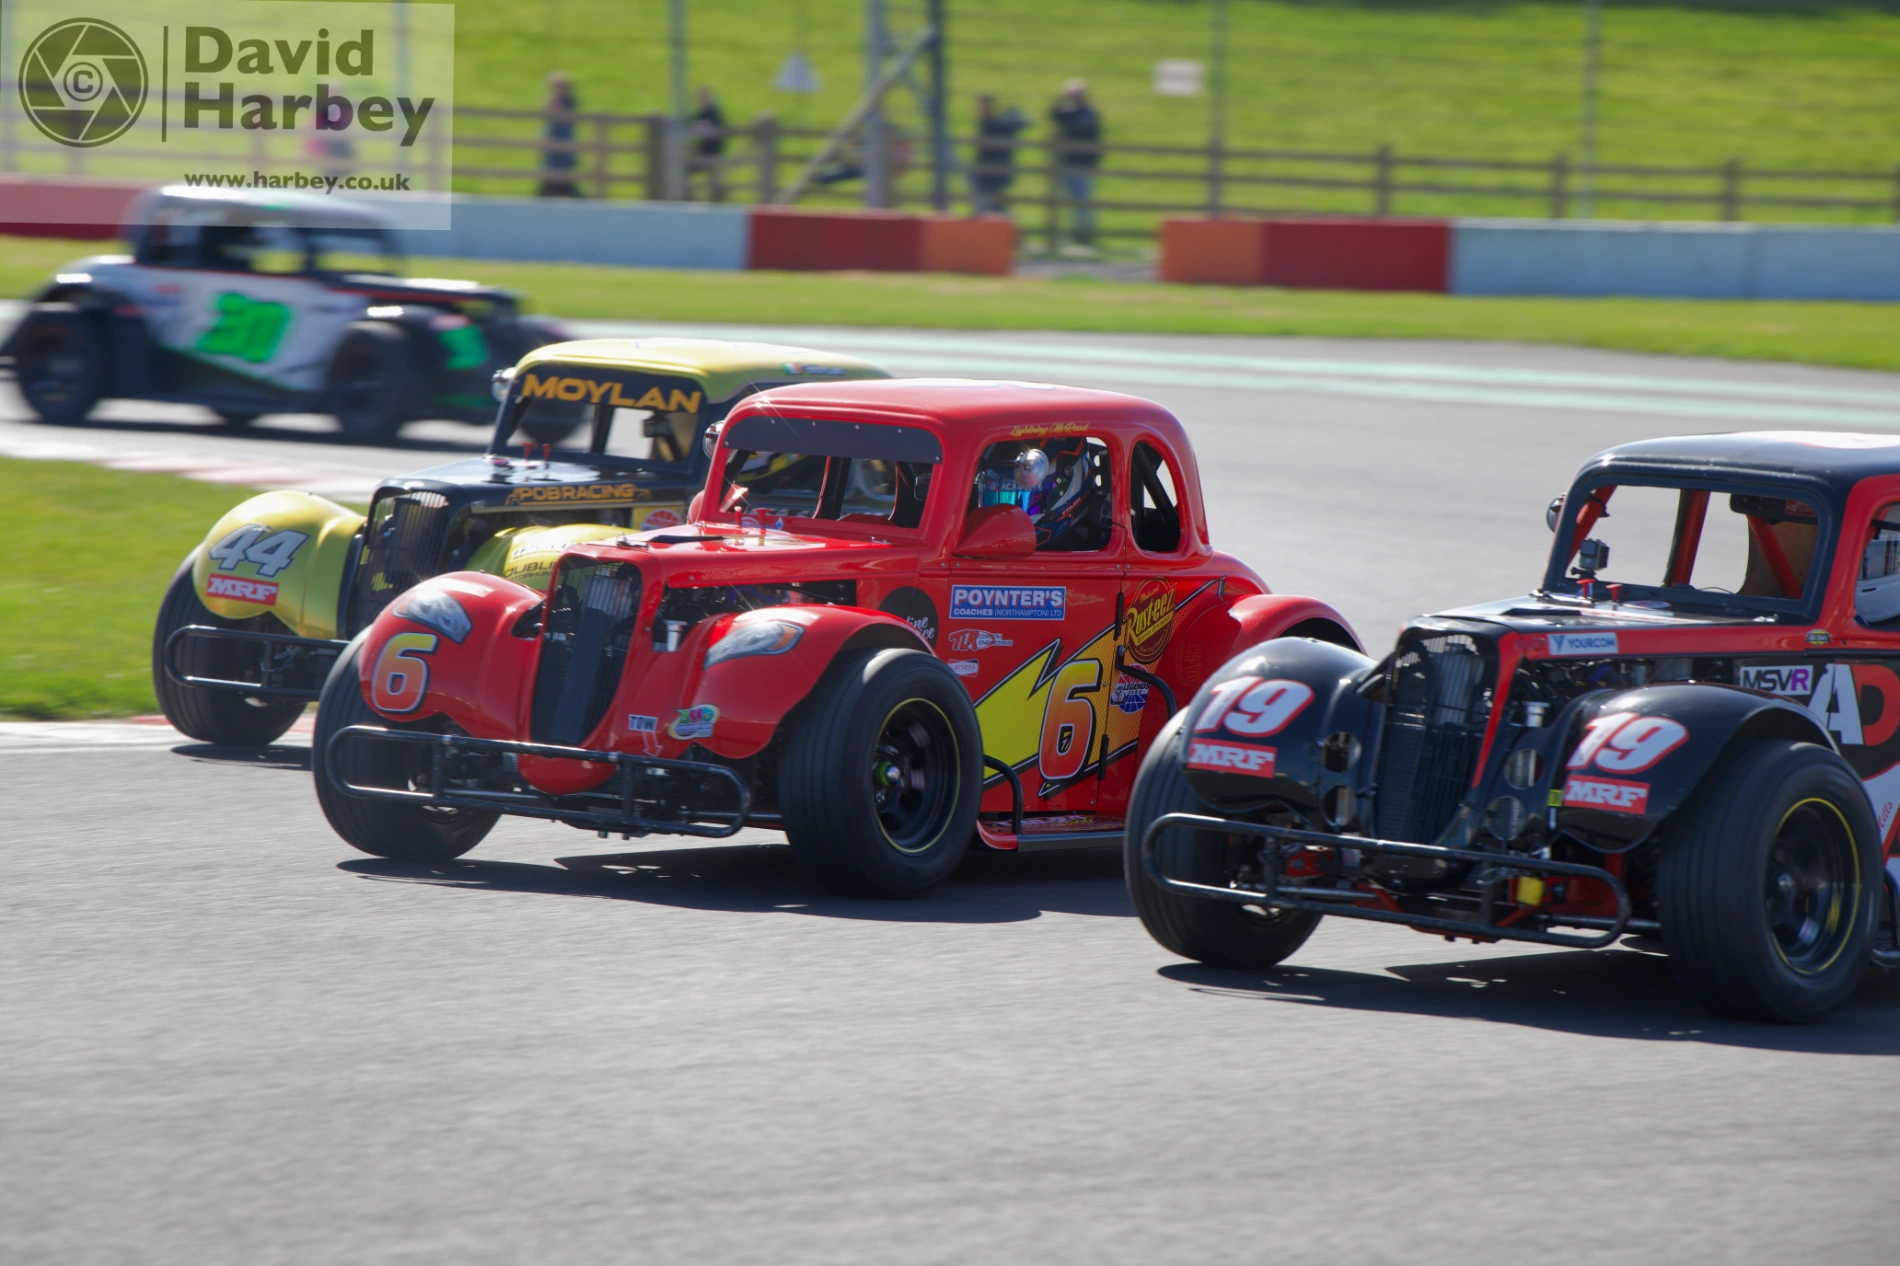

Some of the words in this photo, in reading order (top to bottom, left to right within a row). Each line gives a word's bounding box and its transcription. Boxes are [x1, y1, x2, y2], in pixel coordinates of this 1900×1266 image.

[522, 374, 702, 413] MOYLAN
[208, 523, 311, 578] 44
[207, 577, 278, 601] MRF
[954, 589, 1063, 607] POYNTER'S
[953, 608, 993, 616] COACHES
[994, 608, 1050, 617] (NORTHAMPTON)
[1050, 609, 1062, 617] LTD
[950, 630, 979, 650] TLR
[371, 632, 440, 714] 6
[1743, 668, 1810, 692] MSVR
[1039, 660, 1101, 780] 6
[1193, 675, 1316, 738] 19
[1565, 711, 1690, 774] 19
[1189, 743, 1276, 771] MRF
[1563, 780, 1648, 808] MRF
